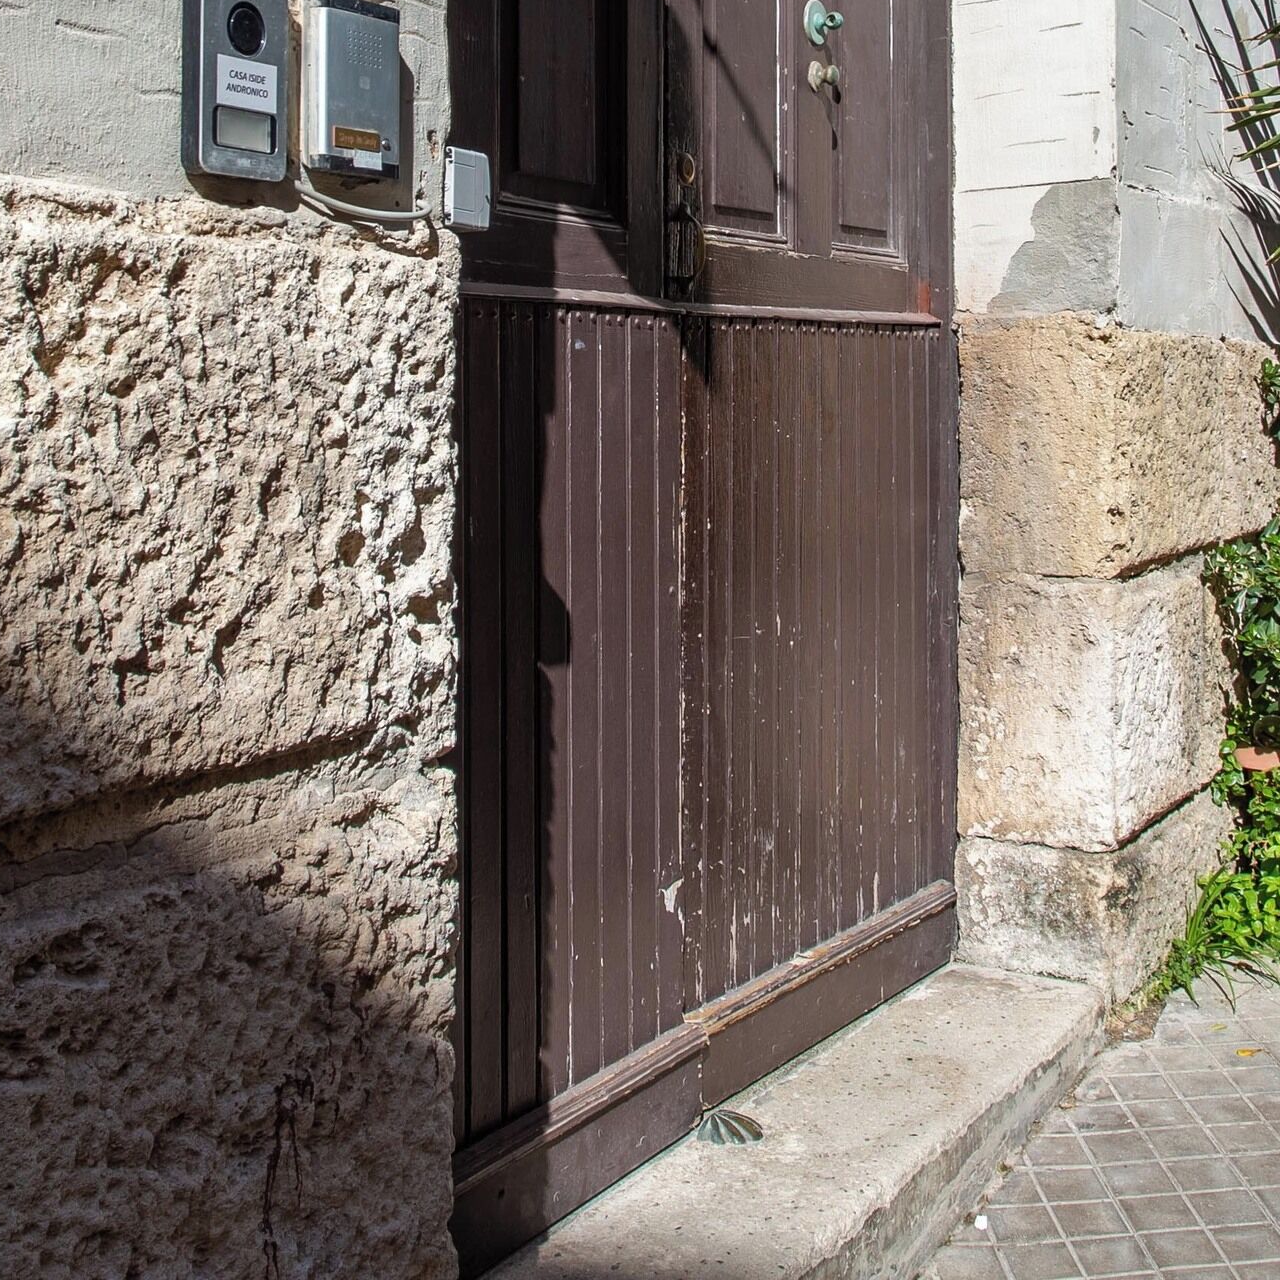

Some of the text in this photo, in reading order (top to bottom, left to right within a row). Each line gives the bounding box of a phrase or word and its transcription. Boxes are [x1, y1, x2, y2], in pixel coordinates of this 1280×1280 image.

[229, 69, 268, 86] CASA ISIDE
[225, 82, 270, 99] ANDRONICO
